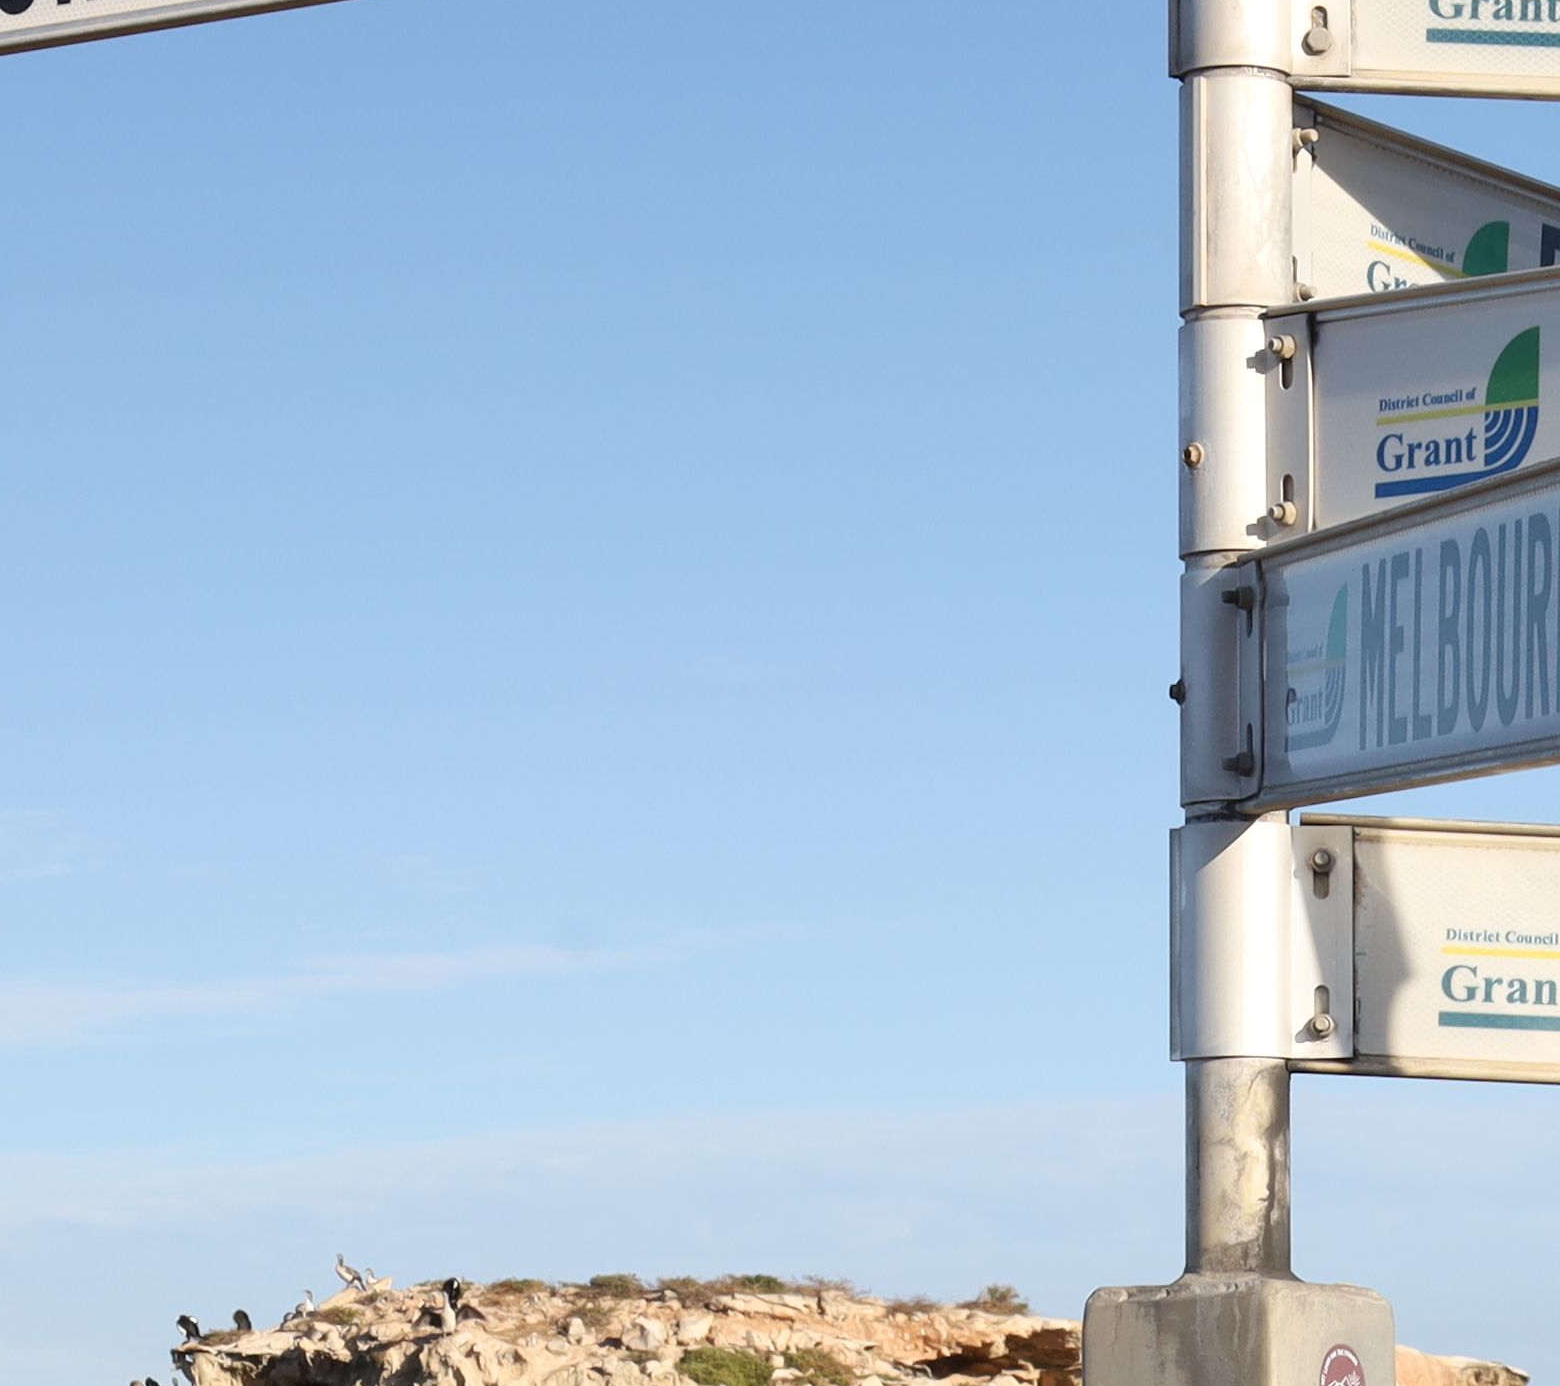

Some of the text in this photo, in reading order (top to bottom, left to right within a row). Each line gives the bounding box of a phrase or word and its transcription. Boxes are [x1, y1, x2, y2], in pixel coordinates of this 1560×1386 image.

[1408, 237, 1444, 260] Council
[1444, 250, 1456, 264] of
[1379, 387, 1477, 412] District Council of
[1376, 426, 1478, 472] Grant
[1445, 928, 1500, 943] District
[1505, 930, 1559, 946] Council
